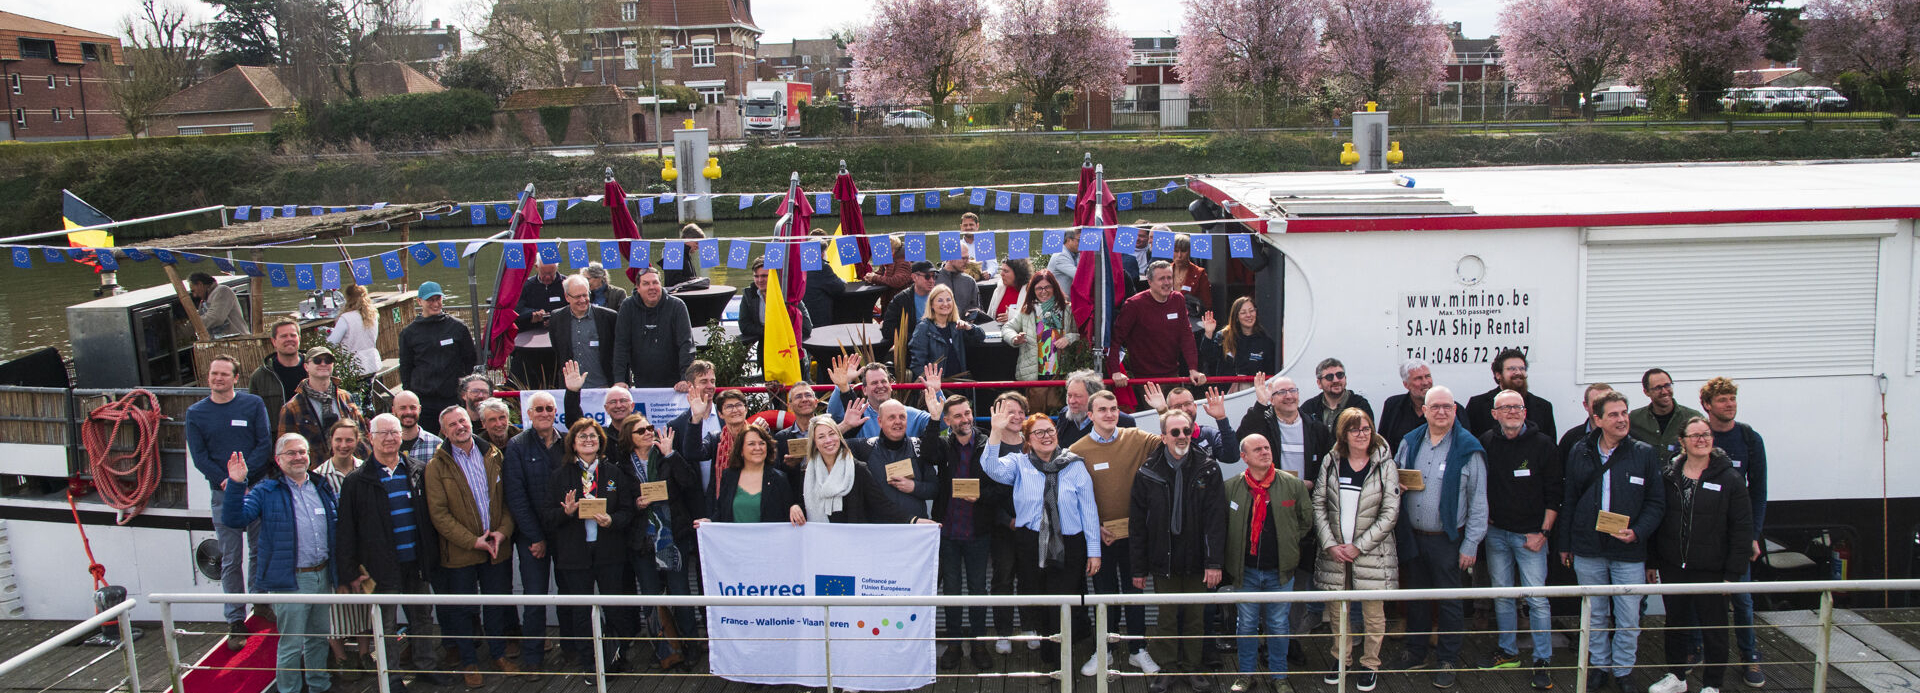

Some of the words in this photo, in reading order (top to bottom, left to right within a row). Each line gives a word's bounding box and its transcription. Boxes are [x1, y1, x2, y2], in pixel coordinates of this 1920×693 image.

[1407, 289, 1529, 308] www.mimino.be
[1407, 319, 1446, 336] SA-VA
[1452, 318, 1481, 339] Ship
[1487, 316, 1530, 335] Rental
[1474, 347, 1488, 362] 72
[721, 616, 748, 626] France
[755, 617, 795, 626] Wallonie
[802, 616, 850, 628] Vlaaneren
